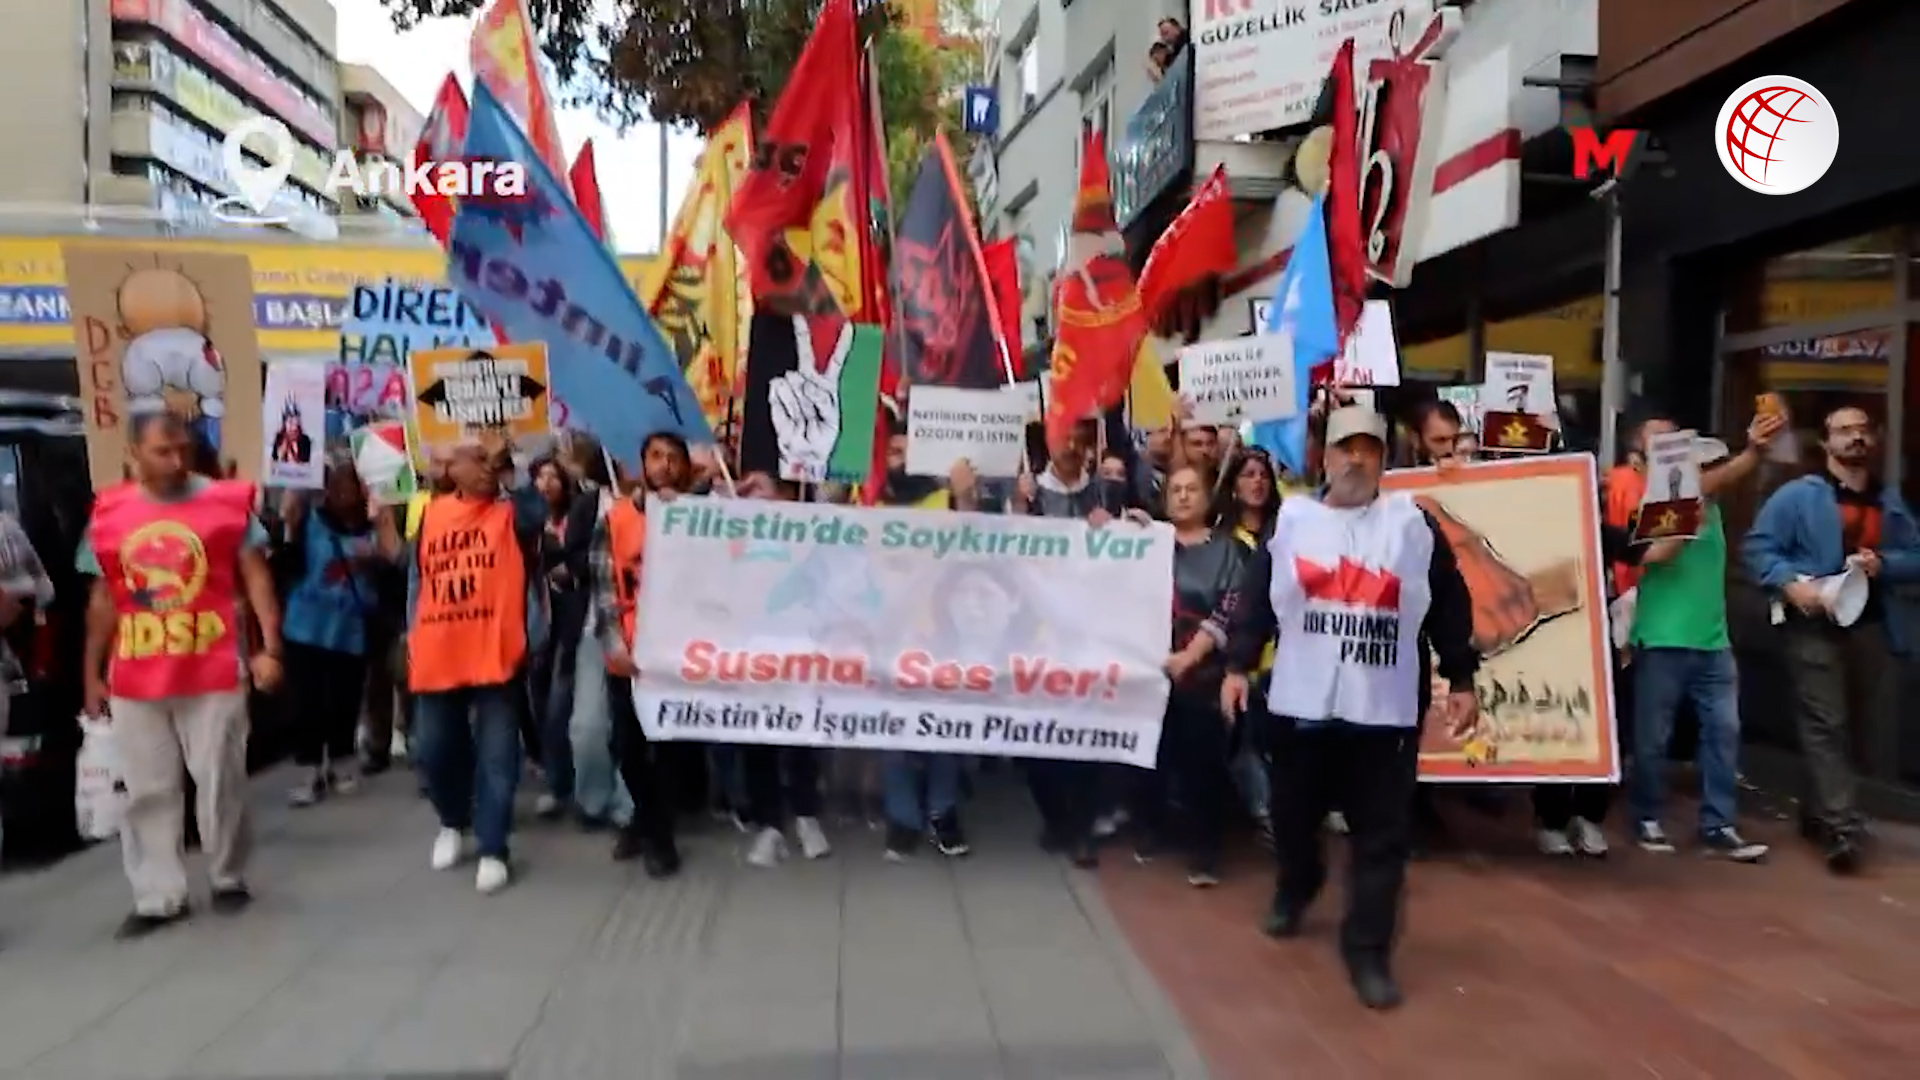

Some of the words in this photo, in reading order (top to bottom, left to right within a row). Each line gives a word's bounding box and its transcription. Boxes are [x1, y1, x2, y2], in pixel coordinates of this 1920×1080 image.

[661, 504, 869, 546] Filistin'de
[880, 520, 1070, 560] Soykırım
[1085, 528, 1154, 560] Var
[894, 649, 995, 694] Ses
[1009, 653, 1123, 700] Ver!
[658, 697, 803, 732] Filistin'de
[813, 696, 906, 741] İşgale
[916, 711, 973, 741] Son
[982, 713, 1139, 754] Platformu
